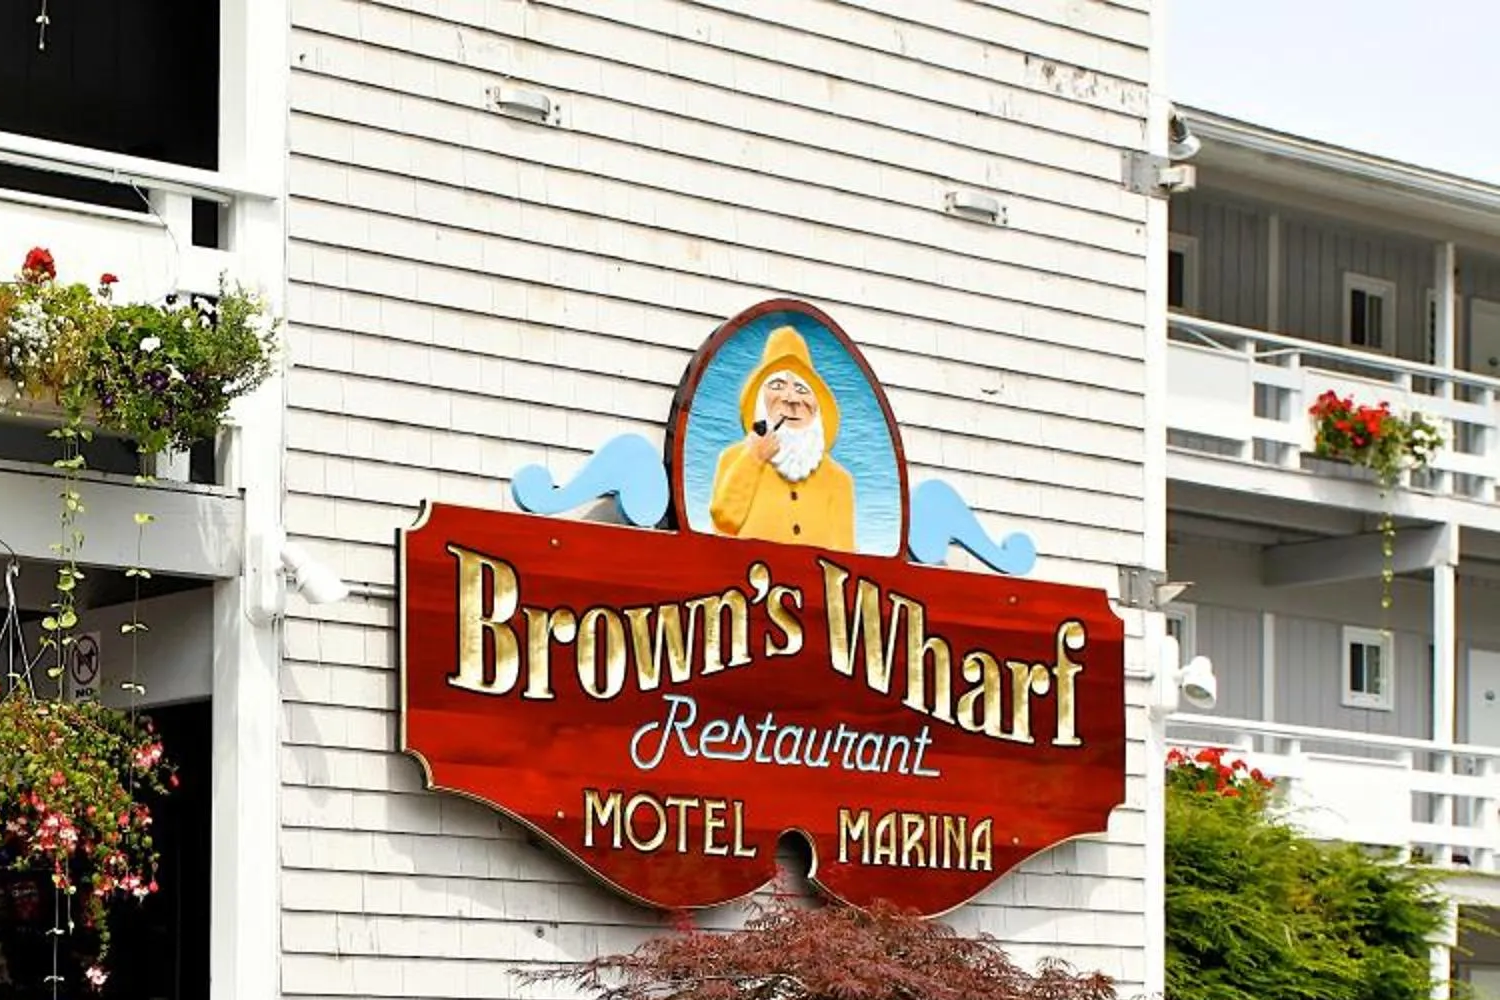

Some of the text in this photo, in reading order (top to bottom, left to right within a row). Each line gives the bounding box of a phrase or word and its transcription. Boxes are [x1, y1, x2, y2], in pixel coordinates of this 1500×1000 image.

[446, 544, 1087, 747] Brown's Wharf
[74, 687, 94, 699] NO
[629, 694, 942, 778] Restaurant
[582, 789, 994, 872] MOTEL MARINA
